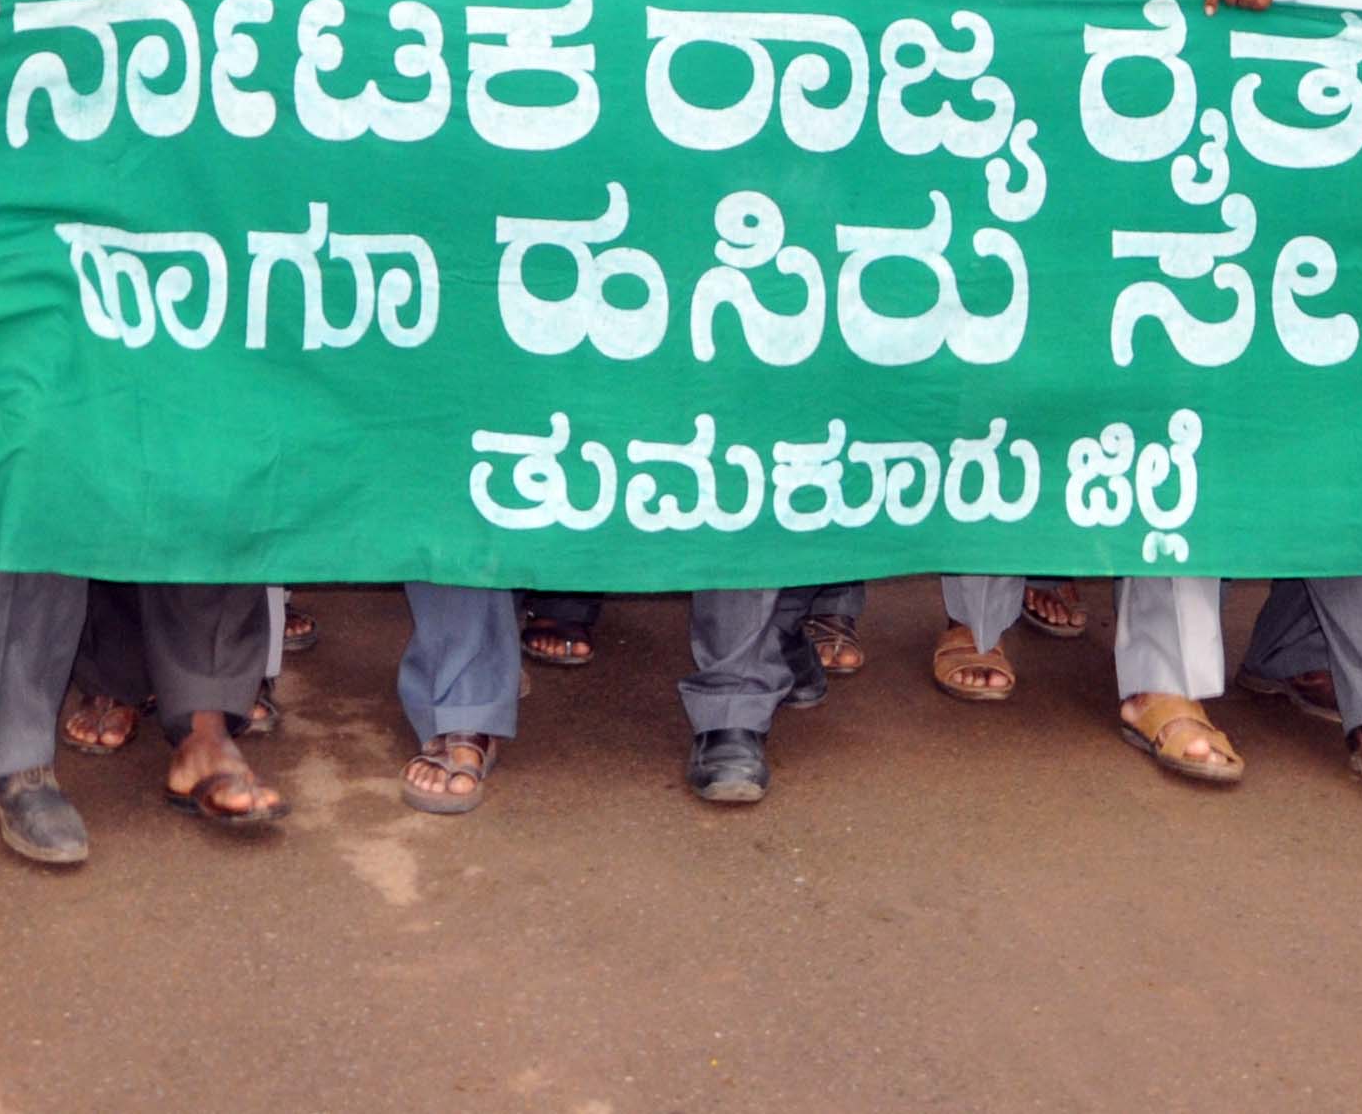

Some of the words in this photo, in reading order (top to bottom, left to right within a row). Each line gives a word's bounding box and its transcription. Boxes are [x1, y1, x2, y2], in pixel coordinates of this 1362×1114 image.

[646, 6, 1047, 222] ರಾಜ್ಯ
[55, 201, 440, 349] ಹಾಗೂ
[496, 181, 1029, 365] ಹಸಿರು
[469, 411, 1040, 532] ತುಮಕೂರು
[1065, 408, 1203, 563] ಜಿಲ್ಲೆ
